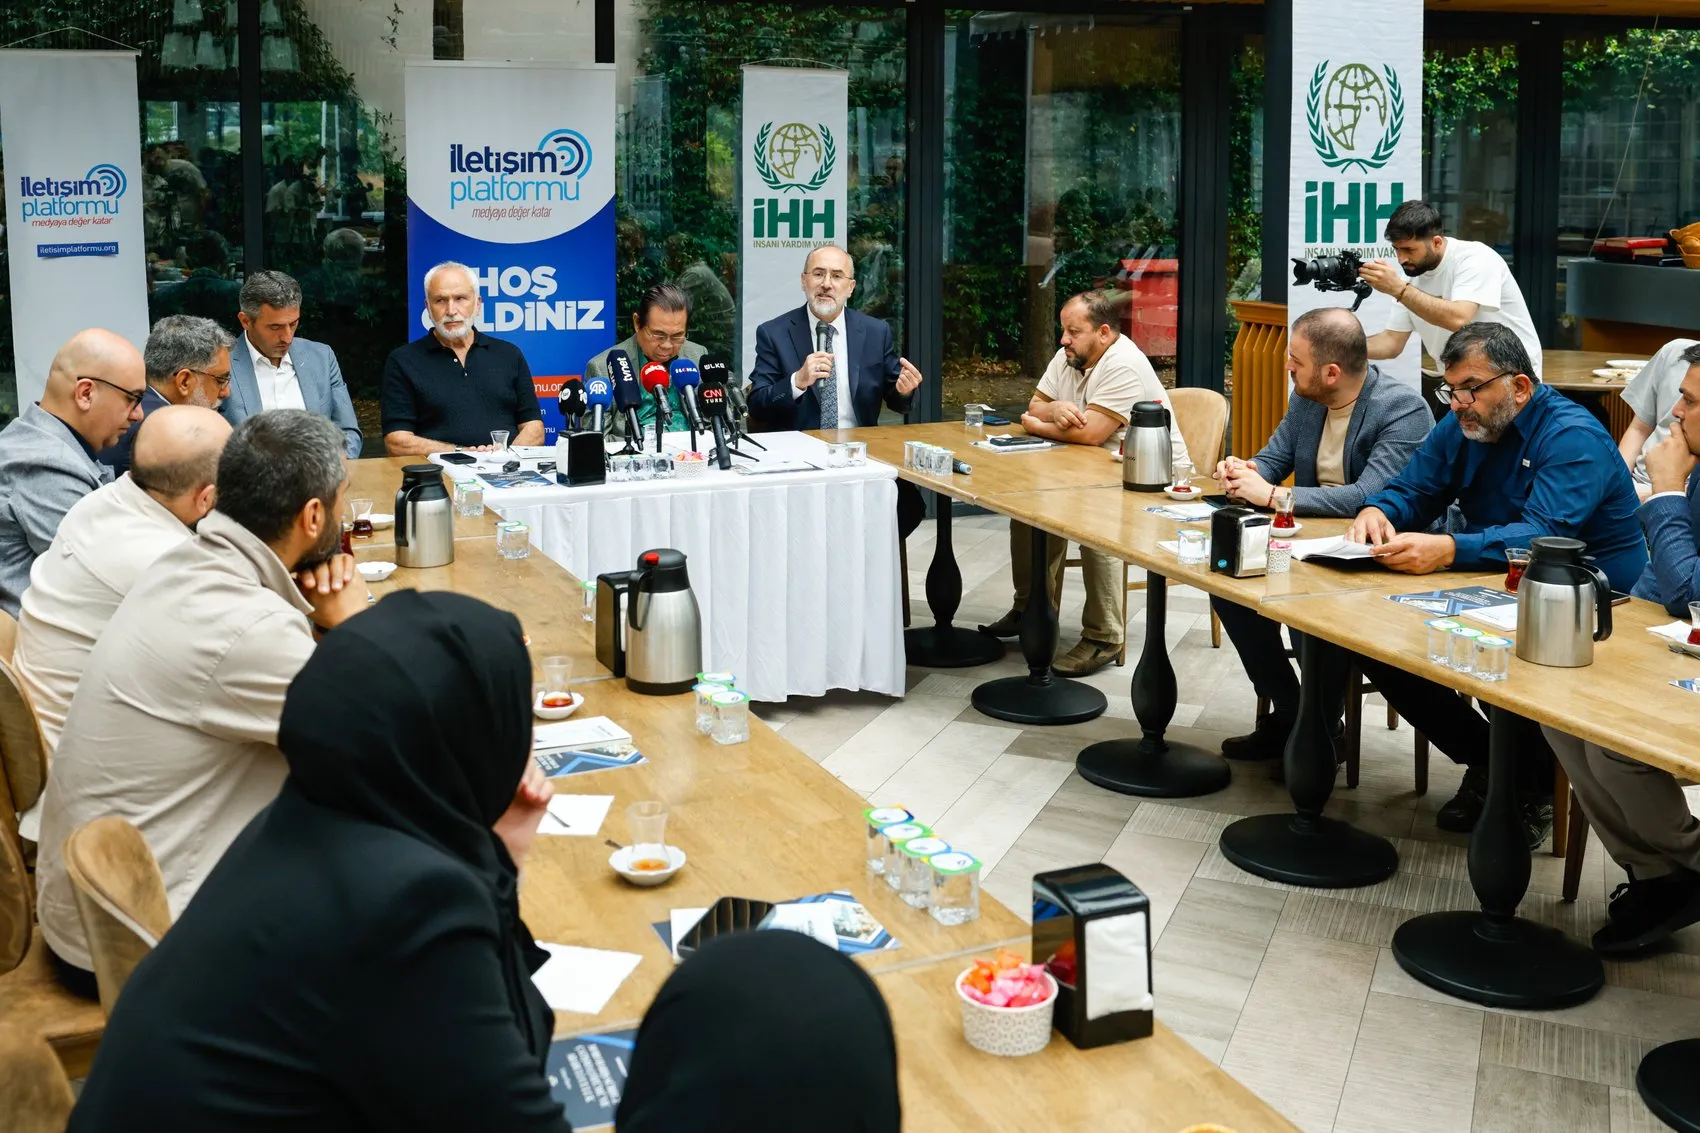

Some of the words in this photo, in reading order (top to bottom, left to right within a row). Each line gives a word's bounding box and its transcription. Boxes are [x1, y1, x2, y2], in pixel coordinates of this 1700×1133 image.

[450, 173, 580, 209] platformu
[22, 196, 119, 222] platformu
[472, 206, 507, 221] medyaya
[507, 205, 530, 221] değer
[531, 205, 552, 218] katar
[32, 218, 67, 228] medyaya
[68, 217, 90, 228] değer
[92, 216, 113, 225] katar
[40, 244, 116, 254] iletisimplatformu.org
[781, 240, 811, 248] YARDIM
[1376, 247, 1398, 258] VAK
[470, 266, 558, 300] HOŞ
[421, 300, 605, 333] LDİNİZ
[617, 357, 633, 382] tvnet
[703, 388, 723, 398] CNN
